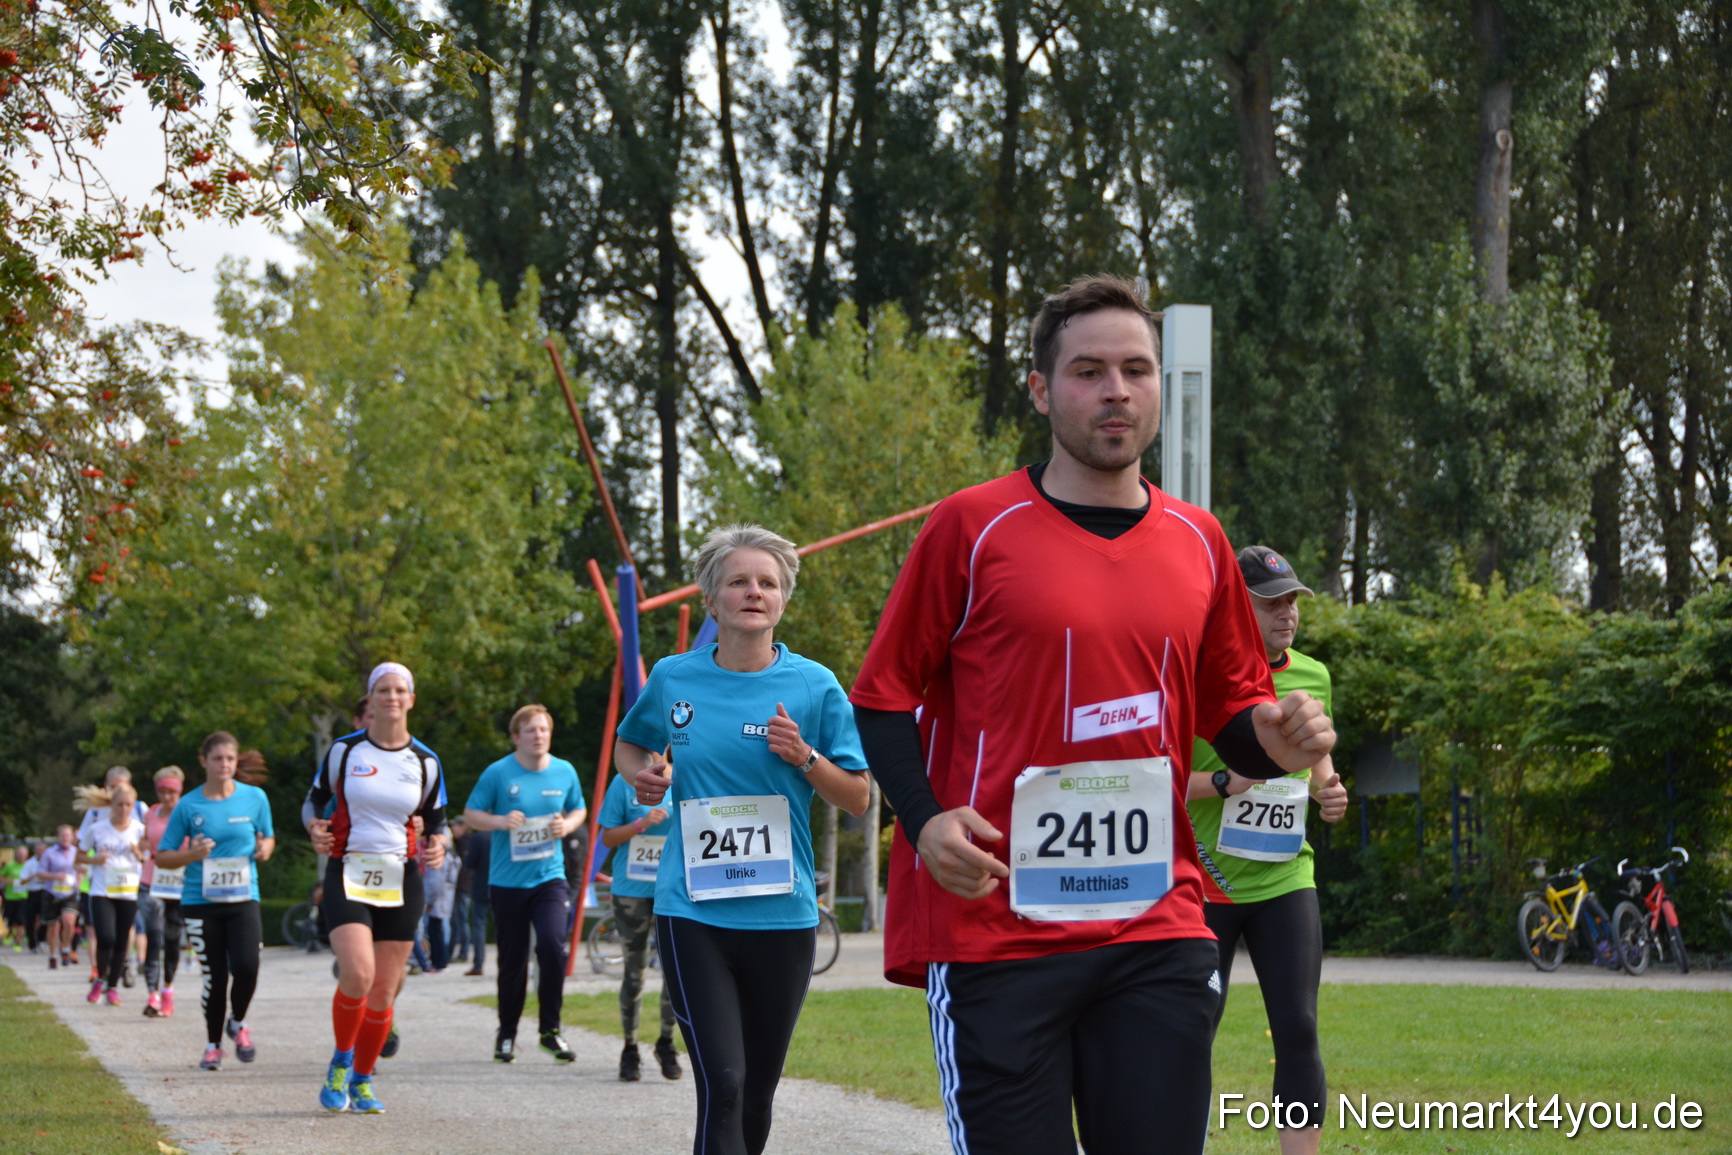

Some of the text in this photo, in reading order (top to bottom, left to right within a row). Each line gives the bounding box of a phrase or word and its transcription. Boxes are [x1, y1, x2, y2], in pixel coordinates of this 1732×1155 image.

[1099, 706, 1139, 727] DEHN
[742, 723, 769, 737] BO
[1076, 775, 1129, 790] BOCK
[721, 804, 758, 815] BOCK
[1235, 800, 1295, 829] 2765
[517, 828, 549, 844] 2213
[1036, 808, 1149, 858] 2410
[699, 824, 771, 860] 2471
[1020, 853, 1027, 862] D
[211, 871, 243, 885] 2171
[363, 871, 383, 887] 75
[725, 867, 757, 880] Ulrike
[1060, 875, 1129, 892] Matthias
